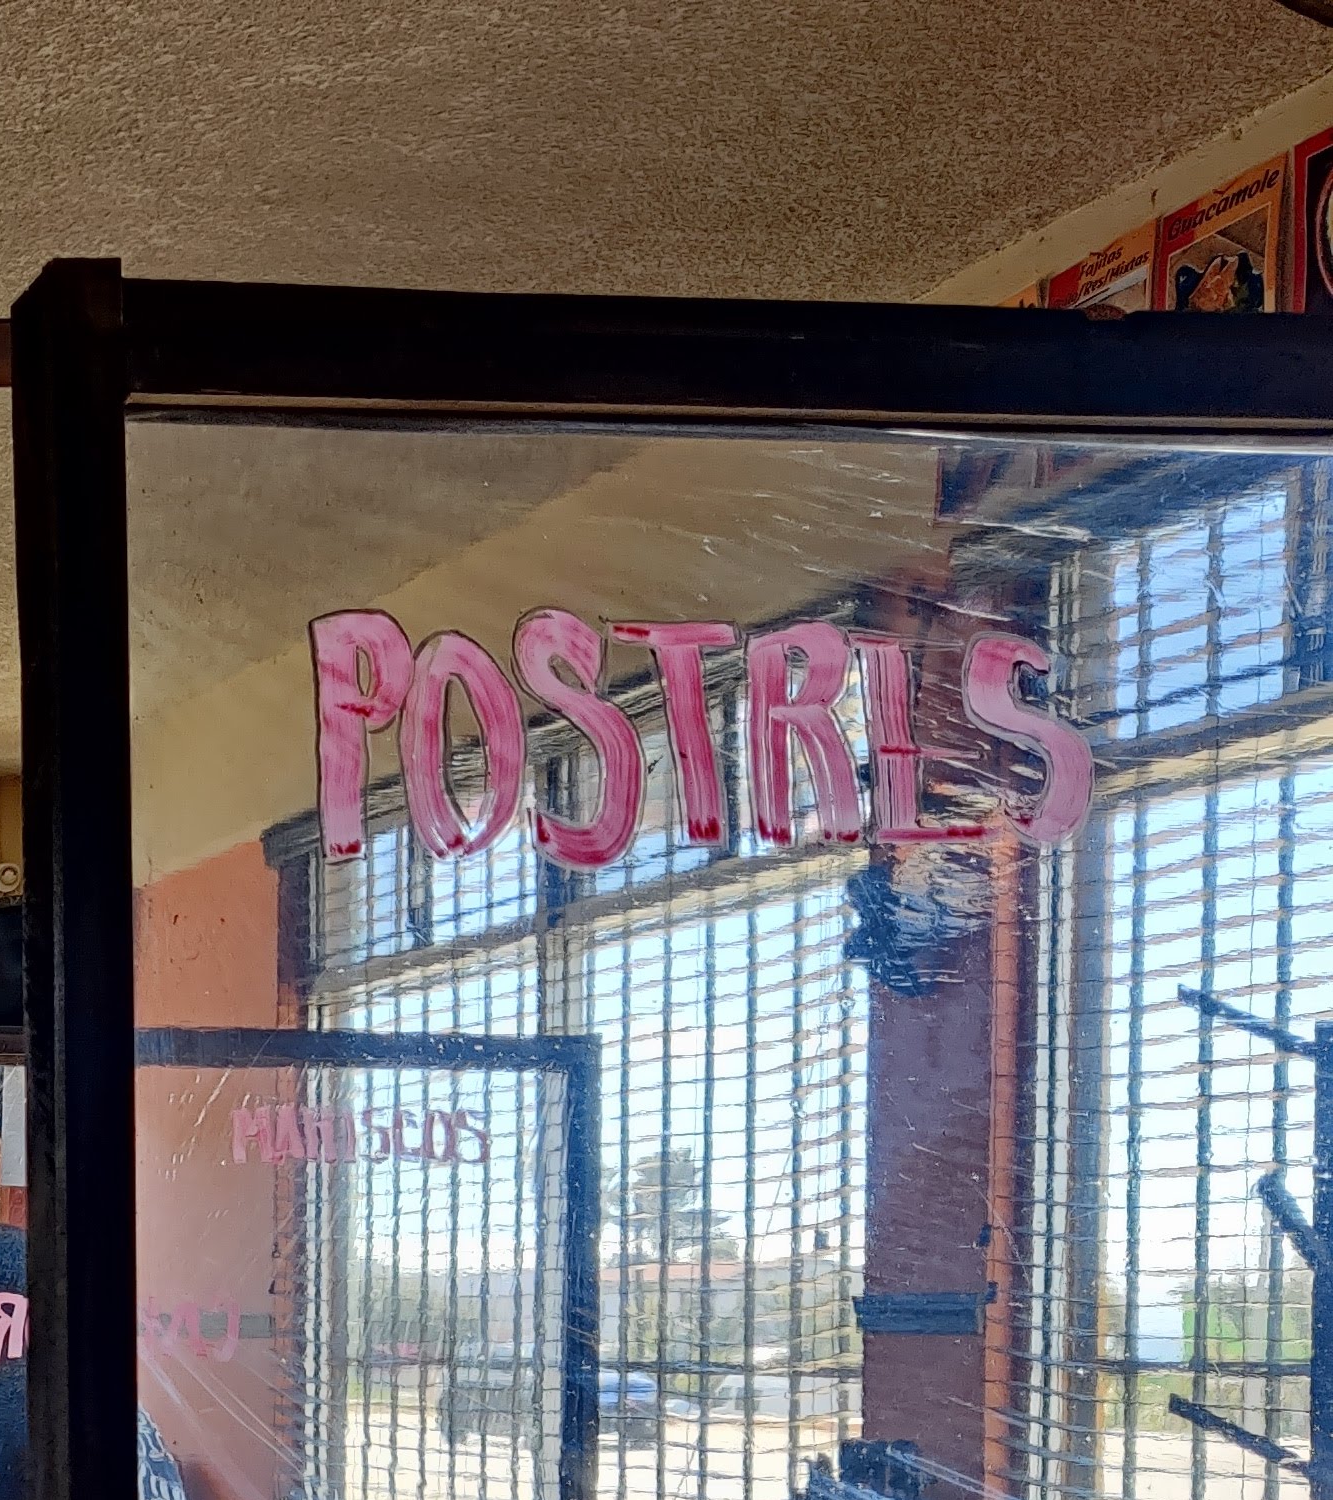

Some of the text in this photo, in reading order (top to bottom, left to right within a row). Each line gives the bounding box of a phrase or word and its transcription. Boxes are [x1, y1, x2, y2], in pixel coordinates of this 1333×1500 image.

[1166, 168, 1281, 241] Guacamole
[1077, 244, 1124, 281] Fajitas
[309, 607, 1095, 871] POSTRES
